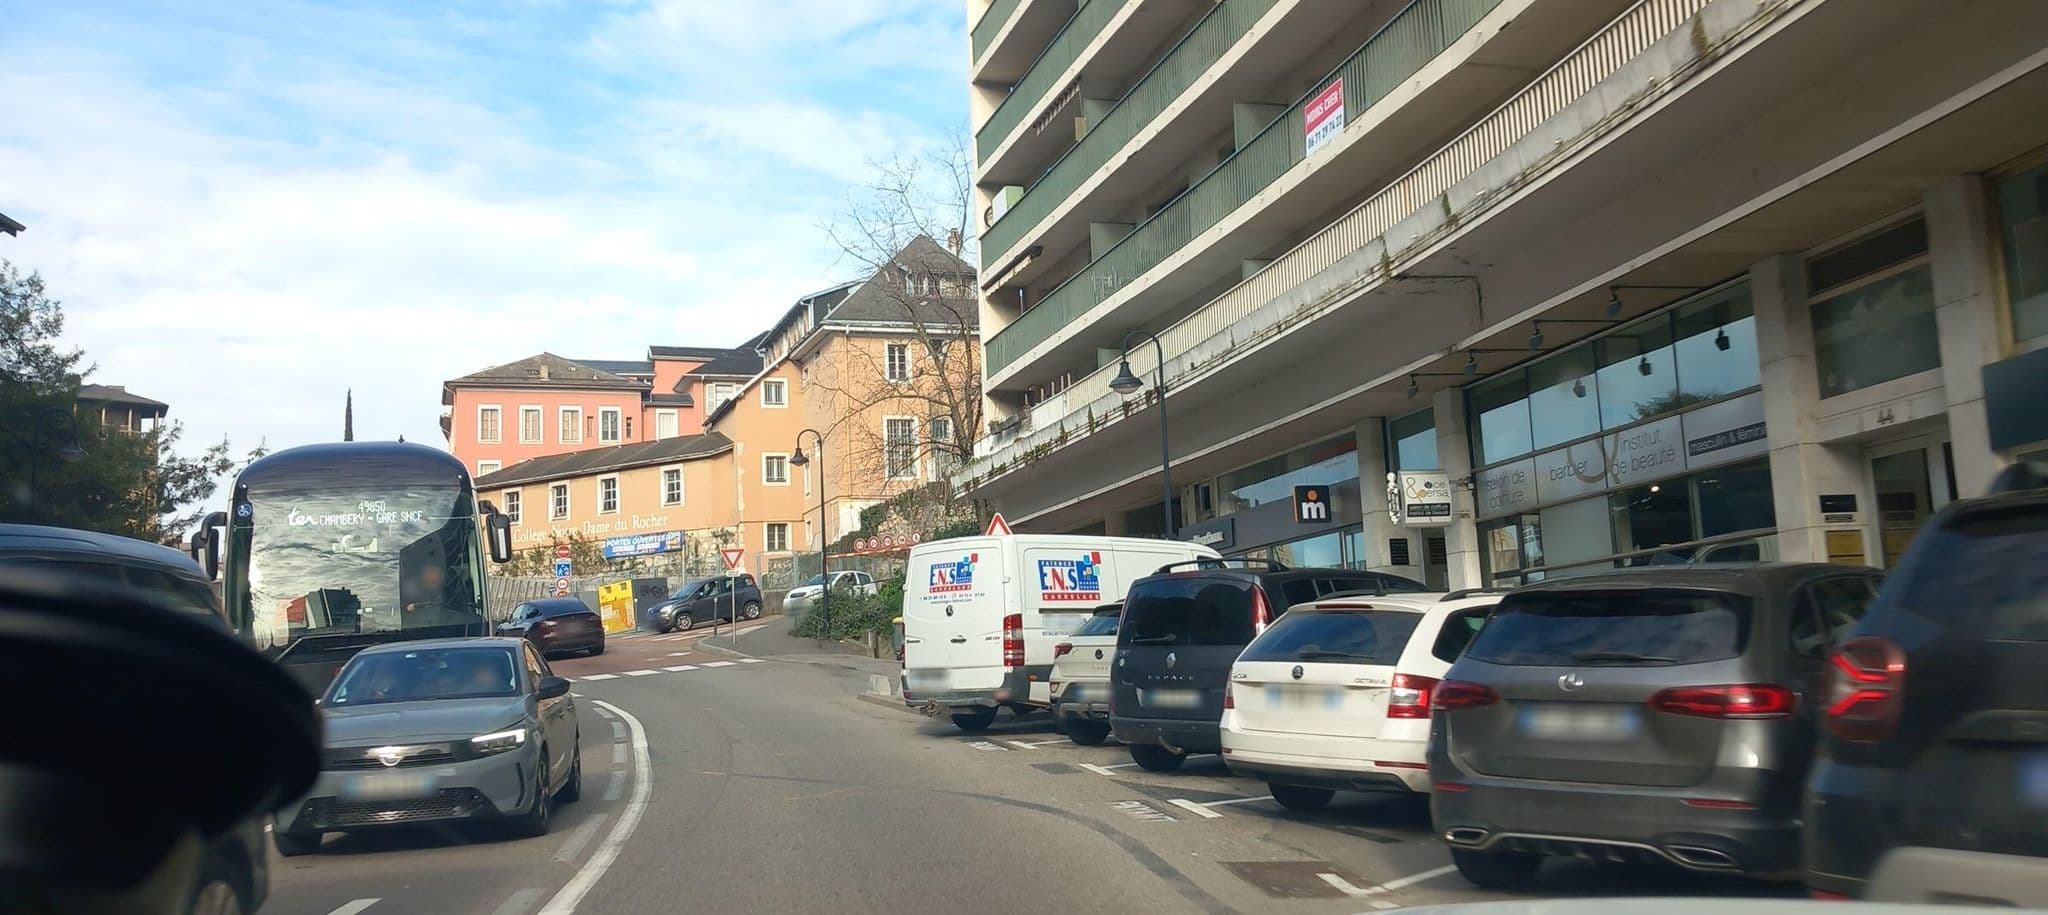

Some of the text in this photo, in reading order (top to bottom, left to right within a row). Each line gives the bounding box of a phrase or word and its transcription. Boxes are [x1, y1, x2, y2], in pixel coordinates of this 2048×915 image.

[358, 500, 386, 513] 49850
[319, 513, 365, 526] CHAMBERY
[376, 511, 398, 523] GARE
[582, 520, 610, 535] Dame
[614, 517, 627, 530] du
[632, 513, 668, 529] Rocher
